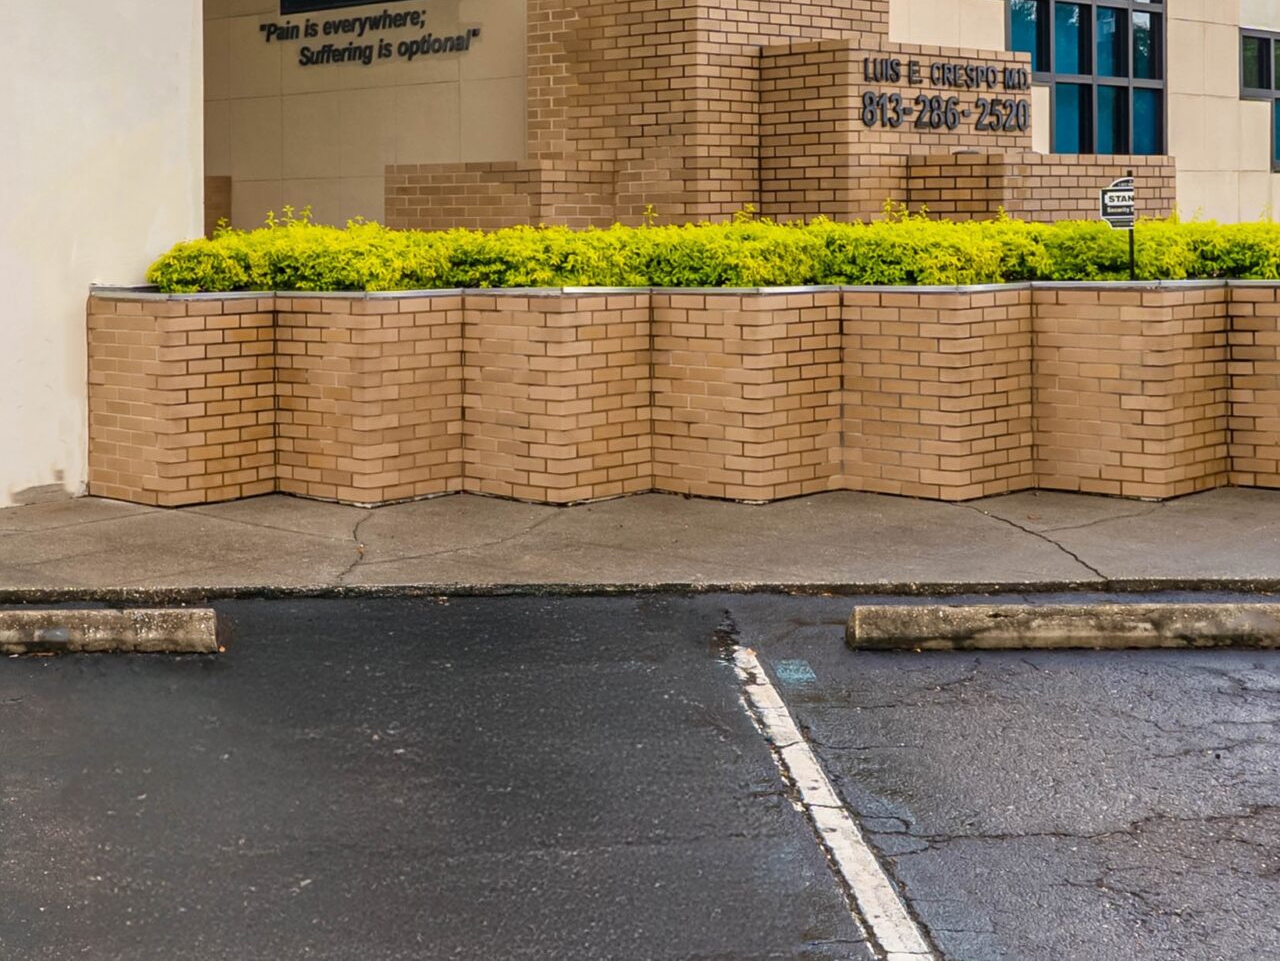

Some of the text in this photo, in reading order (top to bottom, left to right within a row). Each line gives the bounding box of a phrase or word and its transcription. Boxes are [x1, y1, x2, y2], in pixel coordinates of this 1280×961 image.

[259, 9, 427, 42] "Pain is everywhere;
[298, 28, 480, 66] Suffering is optional"
[863, 57, 901, 84] LUIS
[930, 61, 998, 90] CRESPO
[862, 91, 1031, 132] 813-286-2520
